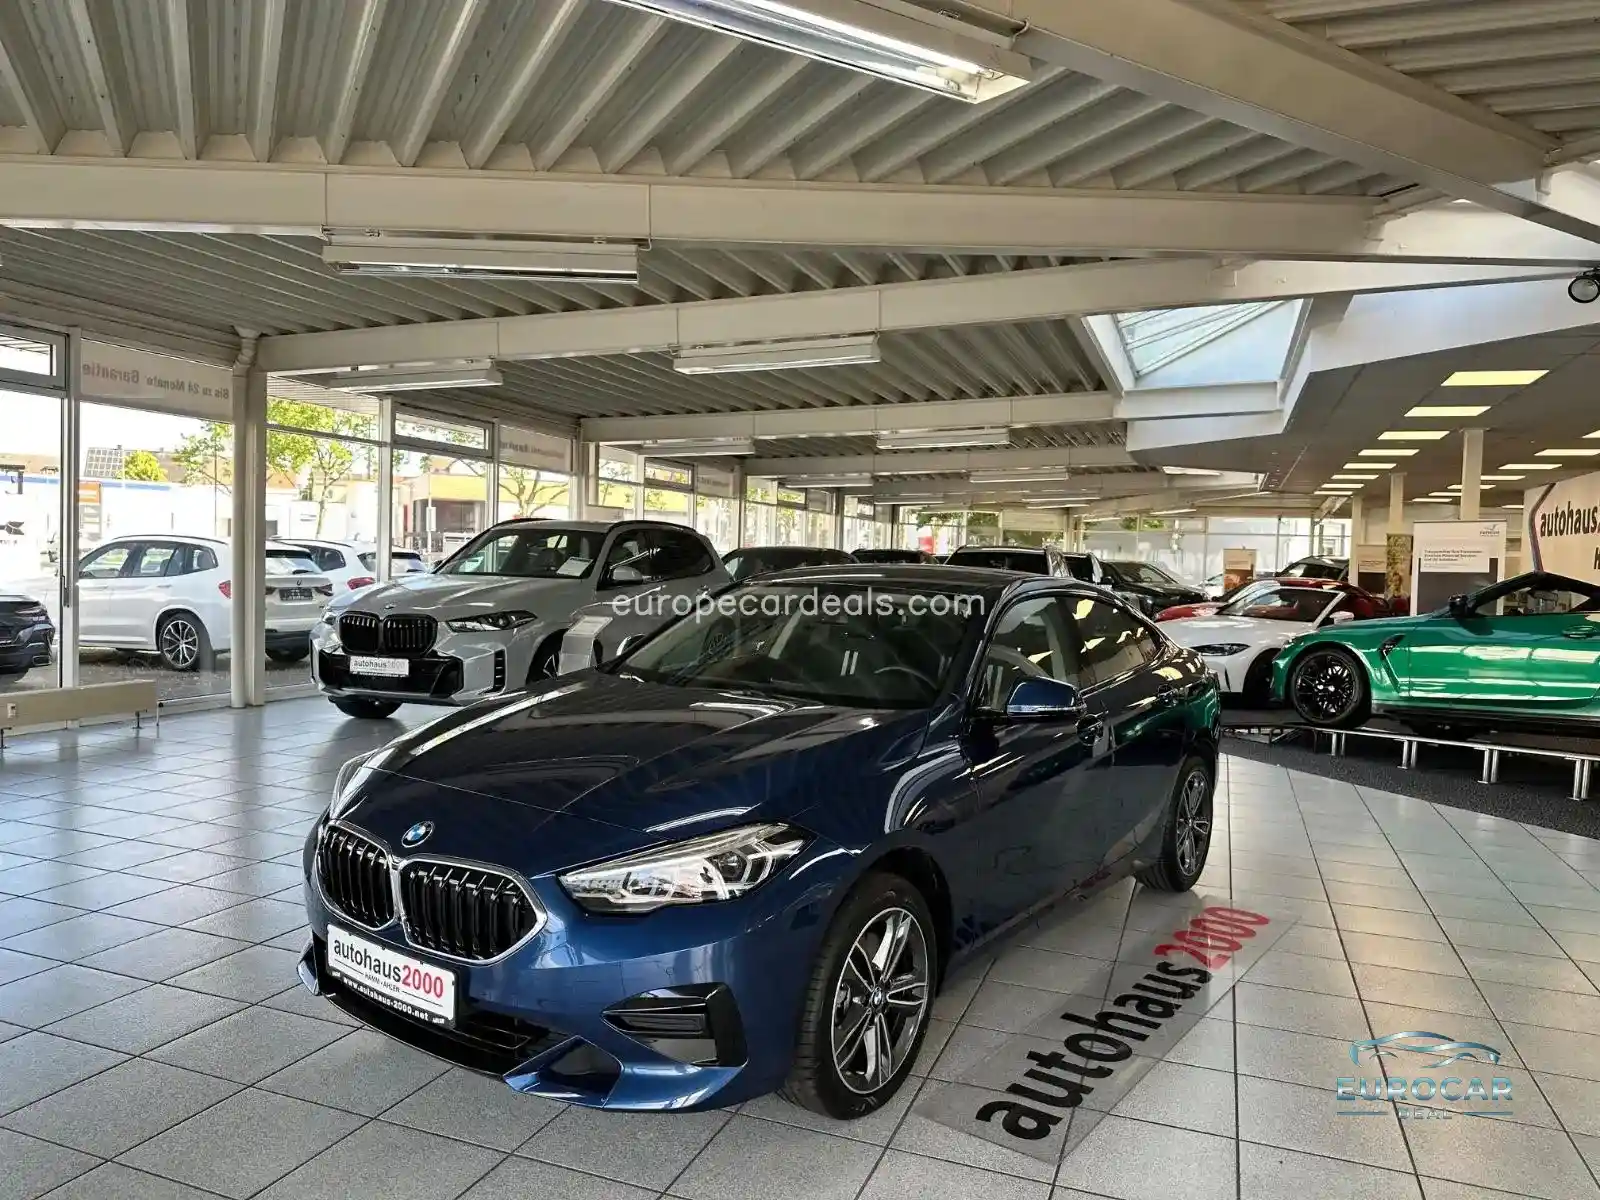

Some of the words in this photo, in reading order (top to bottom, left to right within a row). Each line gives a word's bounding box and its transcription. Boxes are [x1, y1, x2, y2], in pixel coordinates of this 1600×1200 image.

[1540, 500, 1600, 537] autohaus
[333, 939, 444, 998] autohaus2000
[975, 906, 1270, 1140] autohaus2000
